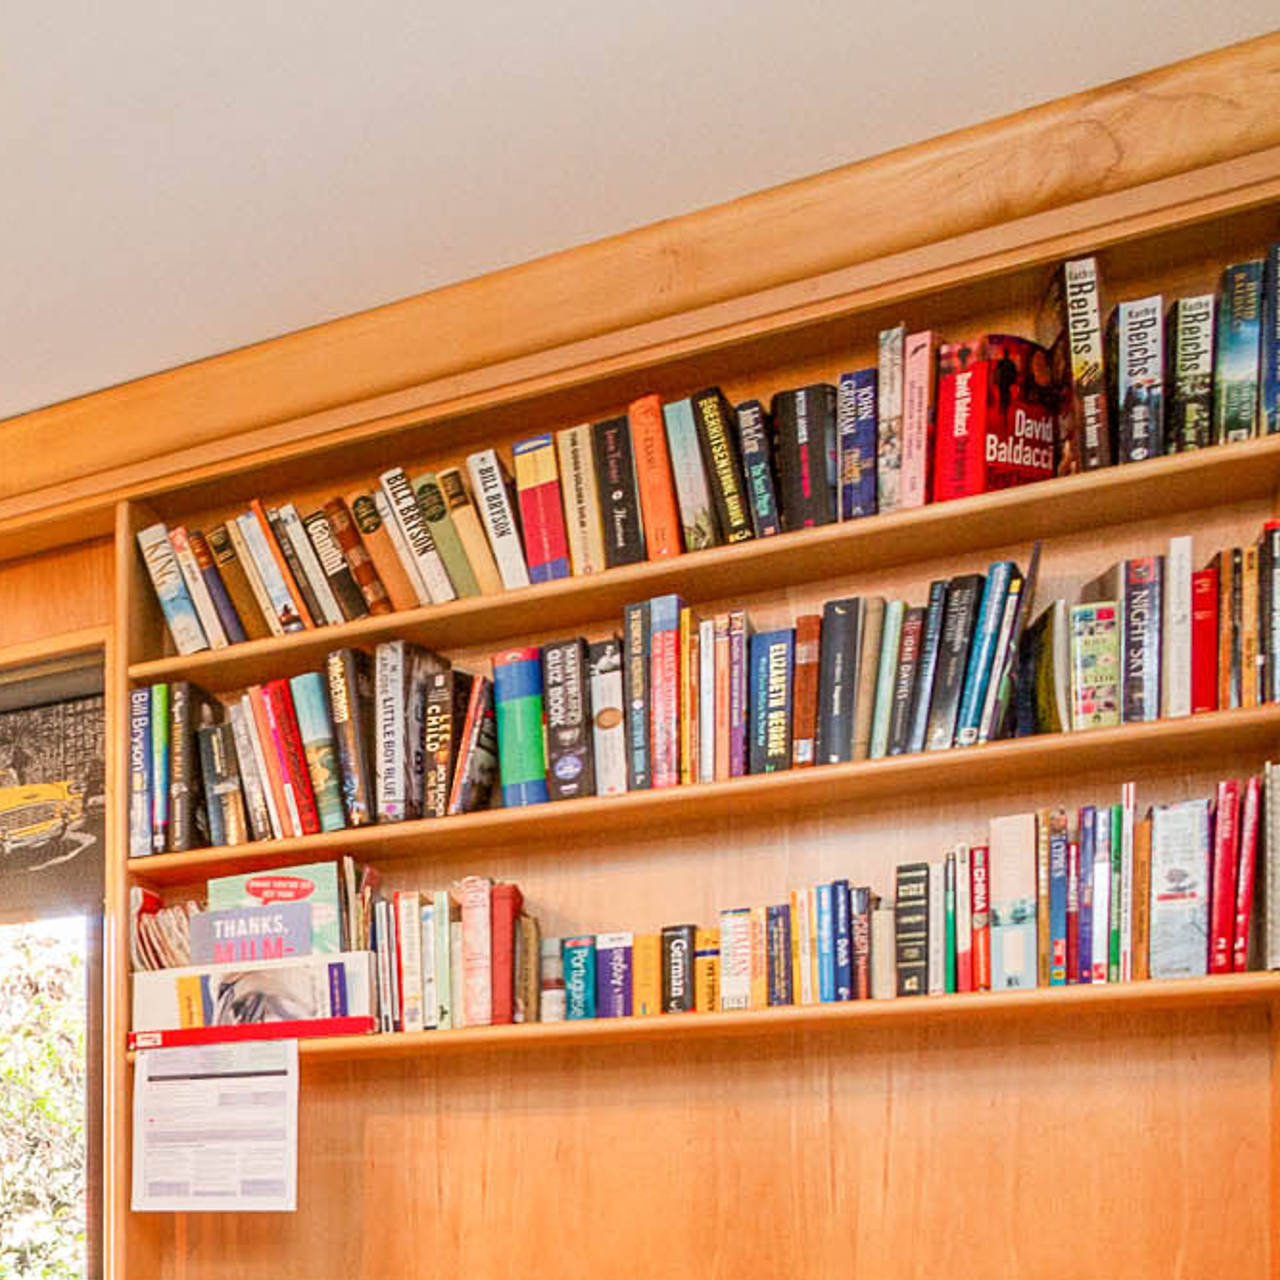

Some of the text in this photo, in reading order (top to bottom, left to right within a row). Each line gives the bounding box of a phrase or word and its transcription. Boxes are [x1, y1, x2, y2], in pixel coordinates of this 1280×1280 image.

[1069, 280, 1100, 355] Reichs
[1128, 317, 1158, 378] Reichs
[1180, 310, 1210, 374] Reichs
[857, 384, 874, 421] JOHN
[1015, 409, 1053, 442] David
[703, 403, 731, 467] GERRITSEN
[986, 433, 1054, 470] Baldacci
[386, 472, 436, 557] BILL BRYSON
[478, 465, 513, 539] BILL BRYSON
[307, 517, 348, 577] Gandhi
[1129, 589, 1151, 678] NIGHT SKY
[547, 649, 565, 727] QUIZ BOOK
[768, 643, 788, 757] ELIZABETH GEORGE
[897, 664, 913, 701] DAVIES
[131, 692, 149, 772] Bill Bryson
[383, 696, 396, 798] LITTLE BOY BLUE
[426, 704, 440, 753] CHILD
[439, 713, 453, 741] LEE
[973, 869, 988, 912] CHINA
[570, 948, 589, 1017] Portuguese
[670, 938, 688, 998] German
